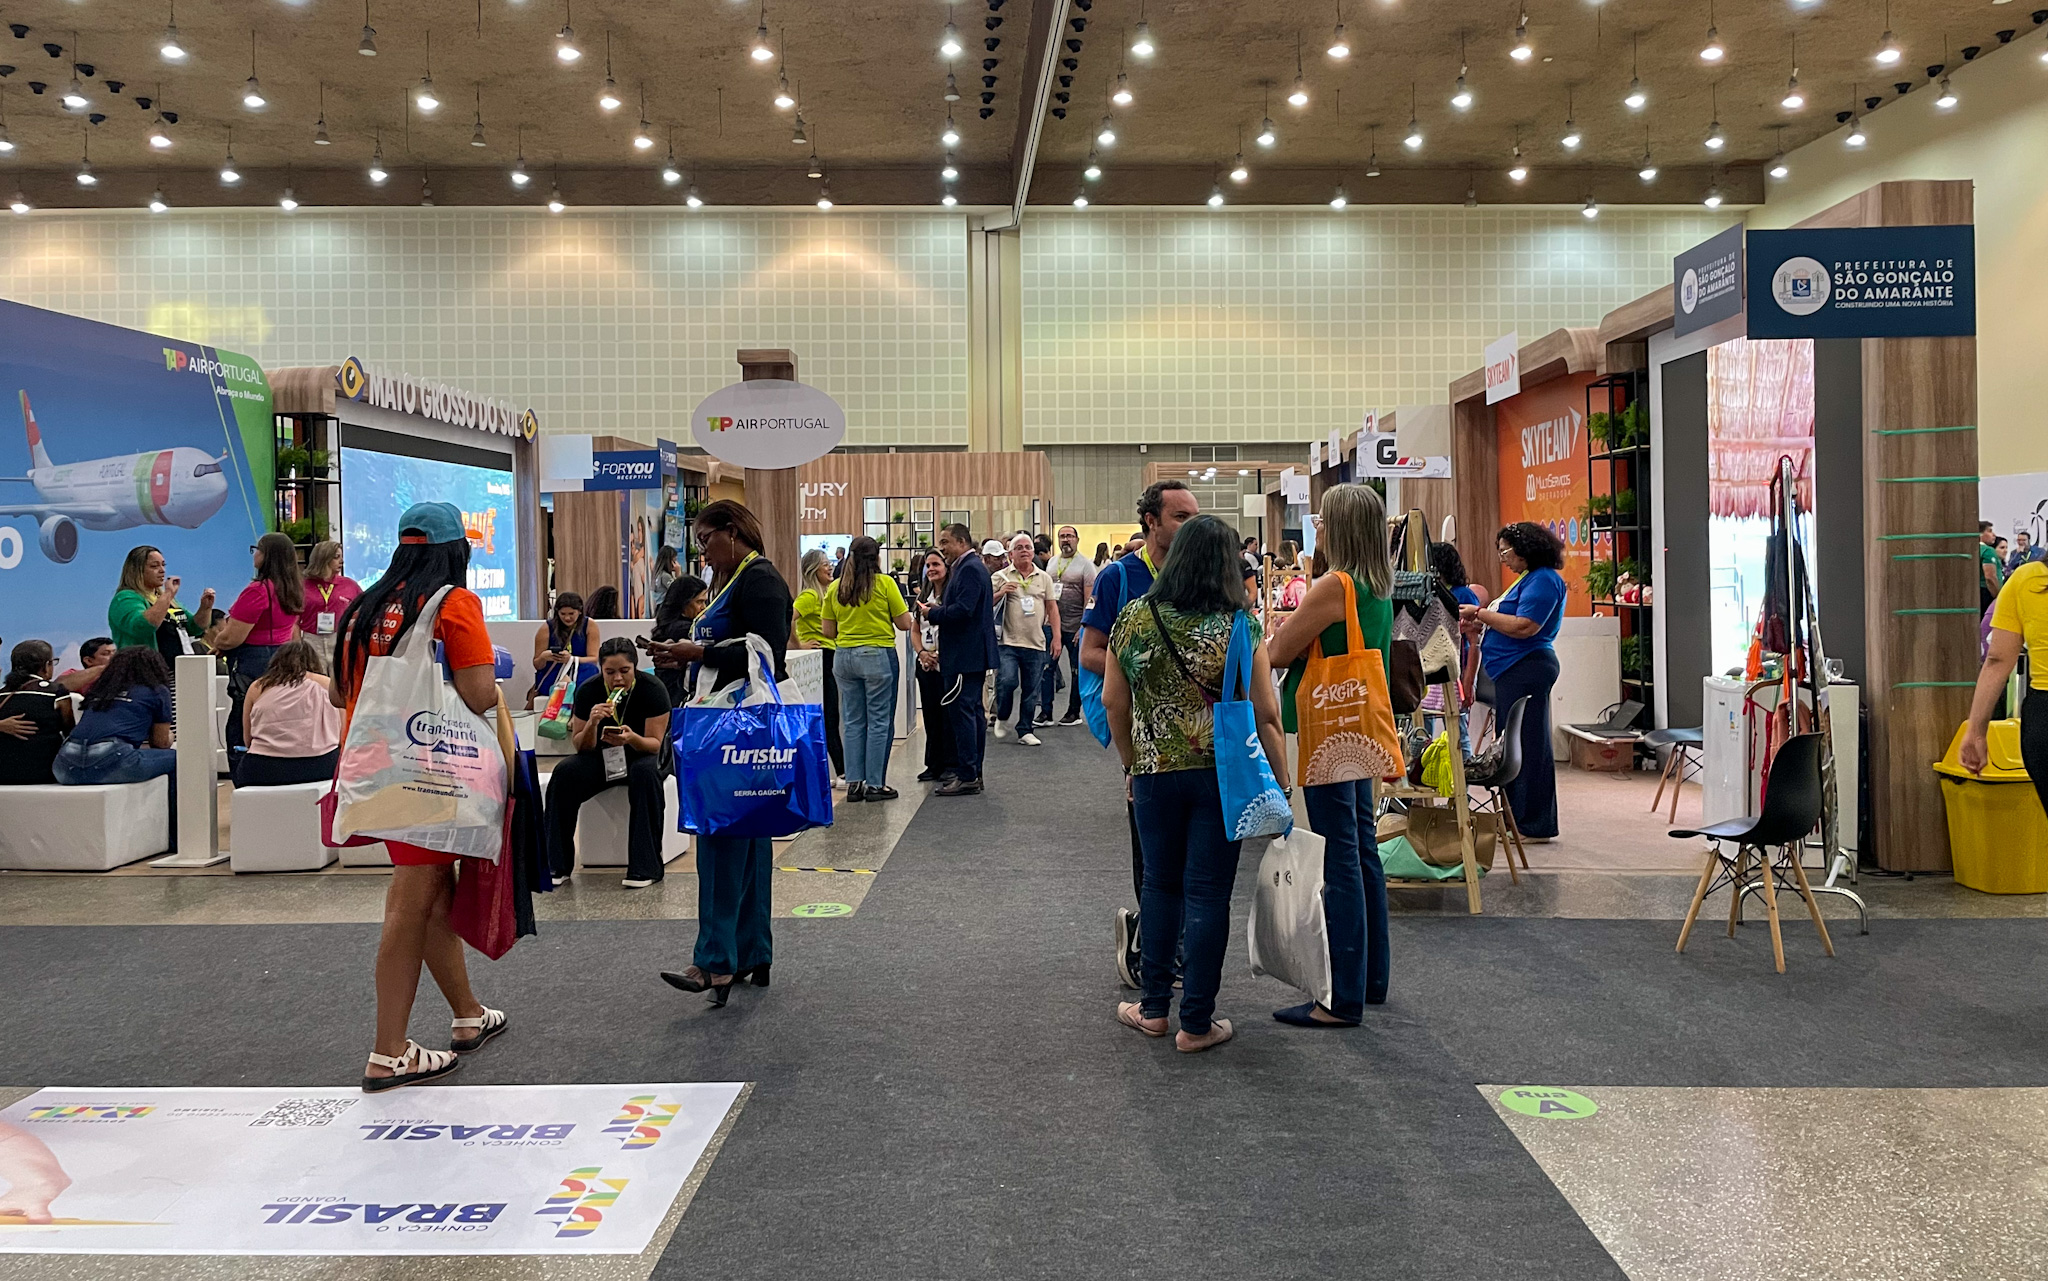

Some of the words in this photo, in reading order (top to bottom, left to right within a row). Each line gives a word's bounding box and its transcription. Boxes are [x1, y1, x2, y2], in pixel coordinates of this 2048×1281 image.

[1835, 260, 1927, 271] PREFEITURA
[1936, 259, 1954, 269] DE
[1834, 270, 1868, 285] SÃO
[1873, 270, 1954, 287] GONÇALO
[1699, 286, 1706, 298] DO
[1835, 288, 1859, 300] DO
[1864, 286, 1954, 300] AMARANTE
[1834, 301, 1884, 309] CONSTRUINDO
[1923, 299, 1954, 307] HISTÓRIA
[163, 347, 187, 372] TAP
[1487, 358, 1510, 389] SKYTEAM
[216, 385, 238, 398] Abraça
[244, 390, 264, 402] Mundo
[368, 366, 416, 415] MATO
[420, 376, 475, 430] GROSSO
[478, 396, 498, 434] DO
[500, 399, 521, 437] SUL
[706, 416, 733, 432] TAP
[1521, 415, 1570, 469] SKYTEAM
[602, 462, 655, 475] FORYOU
[799, 482, 848, 496] URY
[720, 745, 797, 764] Turistur
[758, 788, 786, 797] GAÚCHA
[1513, 1090, 1569, 1099] Rua
[1539, 1100, 1579, 1113] A
[358, 1124, 577, 1141] BRASIL
[260, 1202, 508, 1224] BRASIL
[397, 1225, 489, 1233] CONHEÇA
